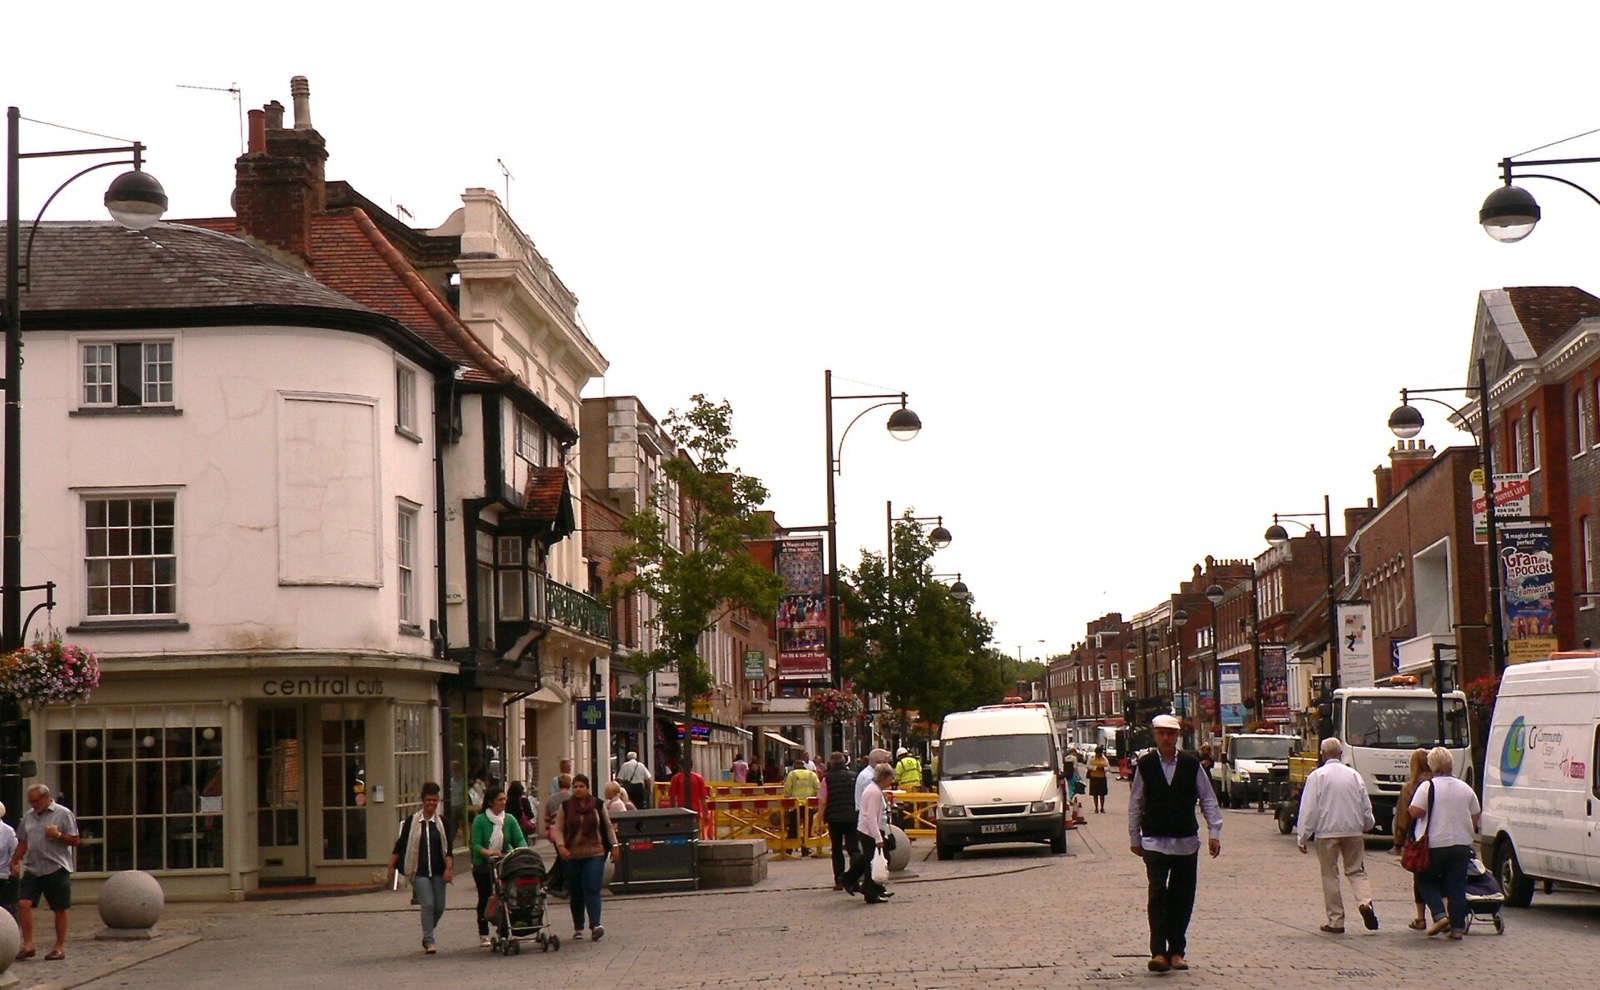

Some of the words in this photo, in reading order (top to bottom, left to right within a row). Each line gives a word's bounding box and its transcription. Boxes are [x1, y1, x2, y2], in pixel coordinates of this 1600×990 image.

[1495, 490, 1513, 503] SUITES
[1514, 485, 1527, 496] LEFT
[1510, 533, 1529, 541] magical
[263, 675, 349, 696] central
[356, 677, 384, 695] cuts
